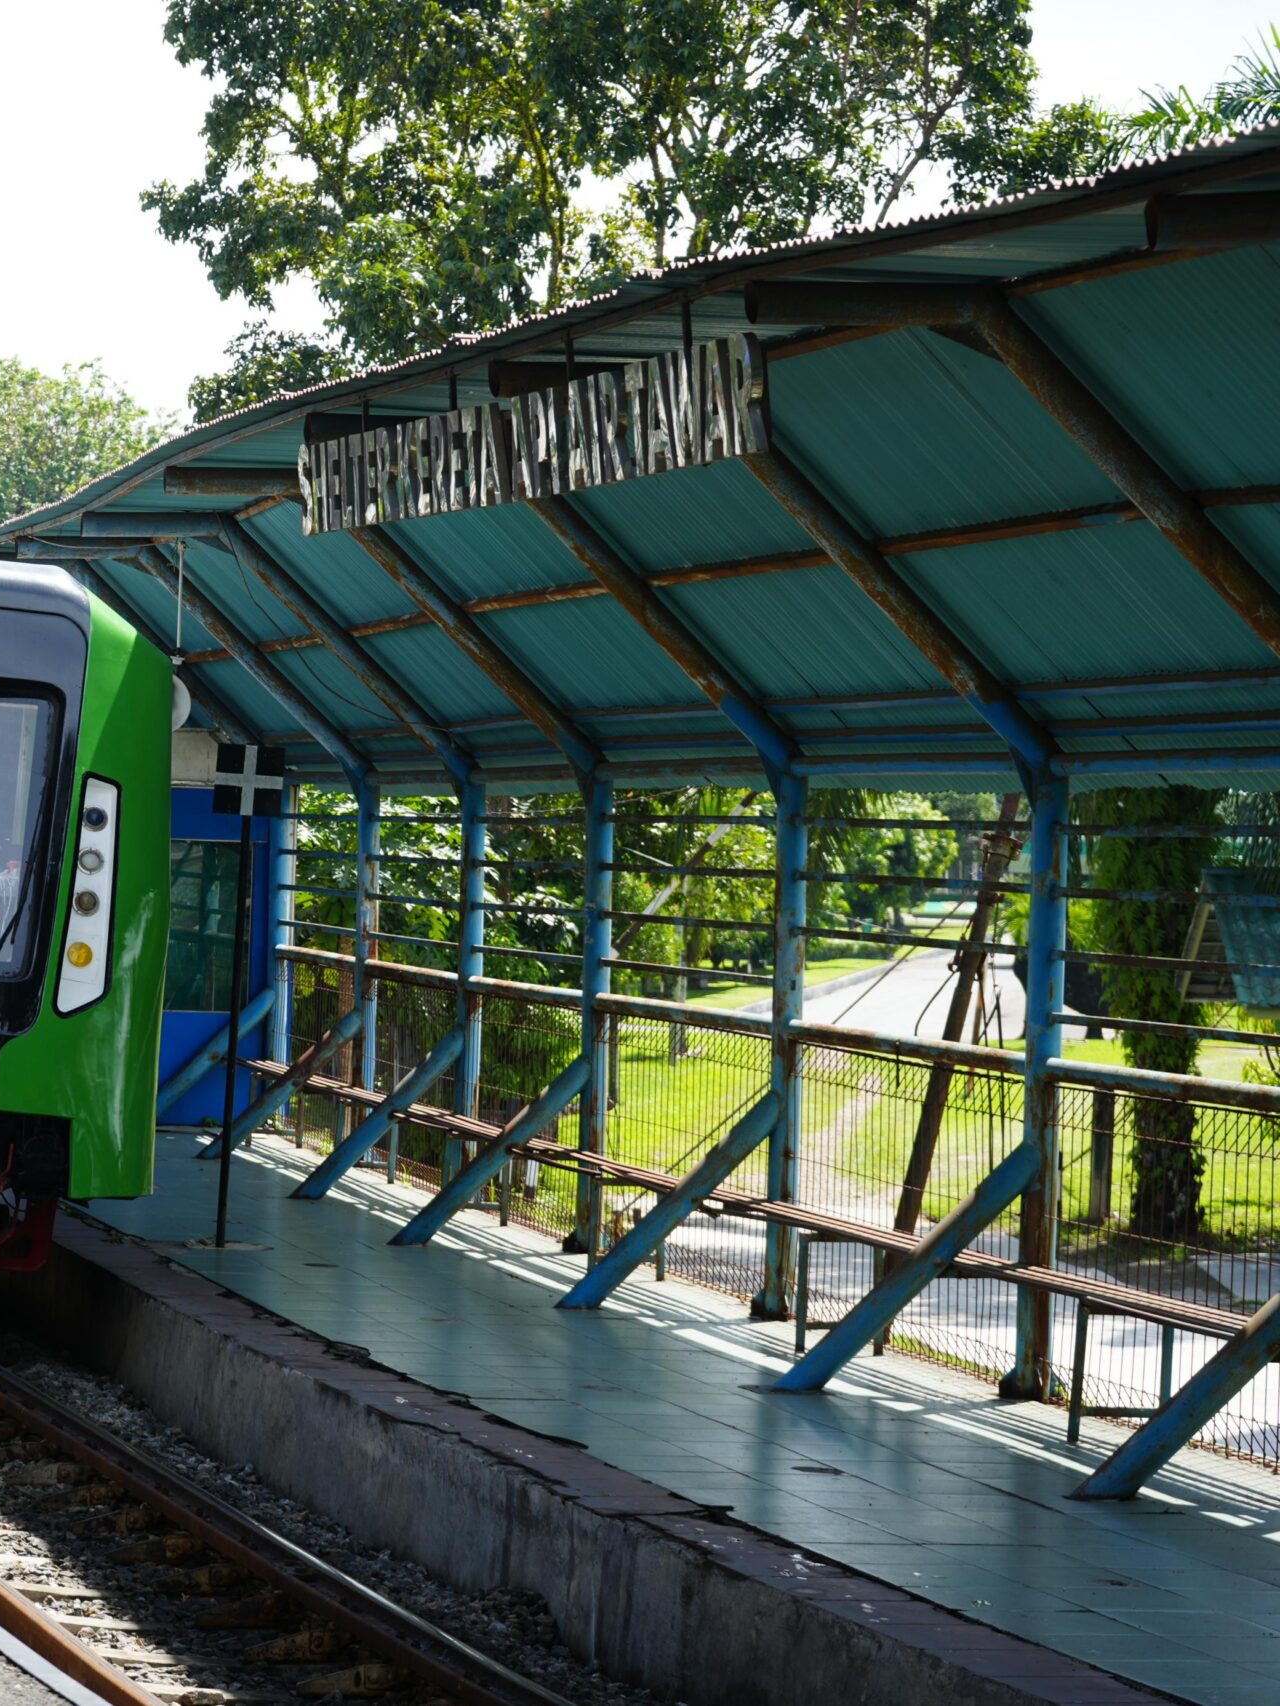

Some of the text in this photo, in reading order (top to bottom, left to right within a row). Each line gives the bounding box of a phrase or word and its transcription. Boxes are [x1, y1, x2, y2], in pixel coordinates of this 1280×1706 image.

[297, 332, 768, 537] SHELTER KERETA API AIR TAWAR
